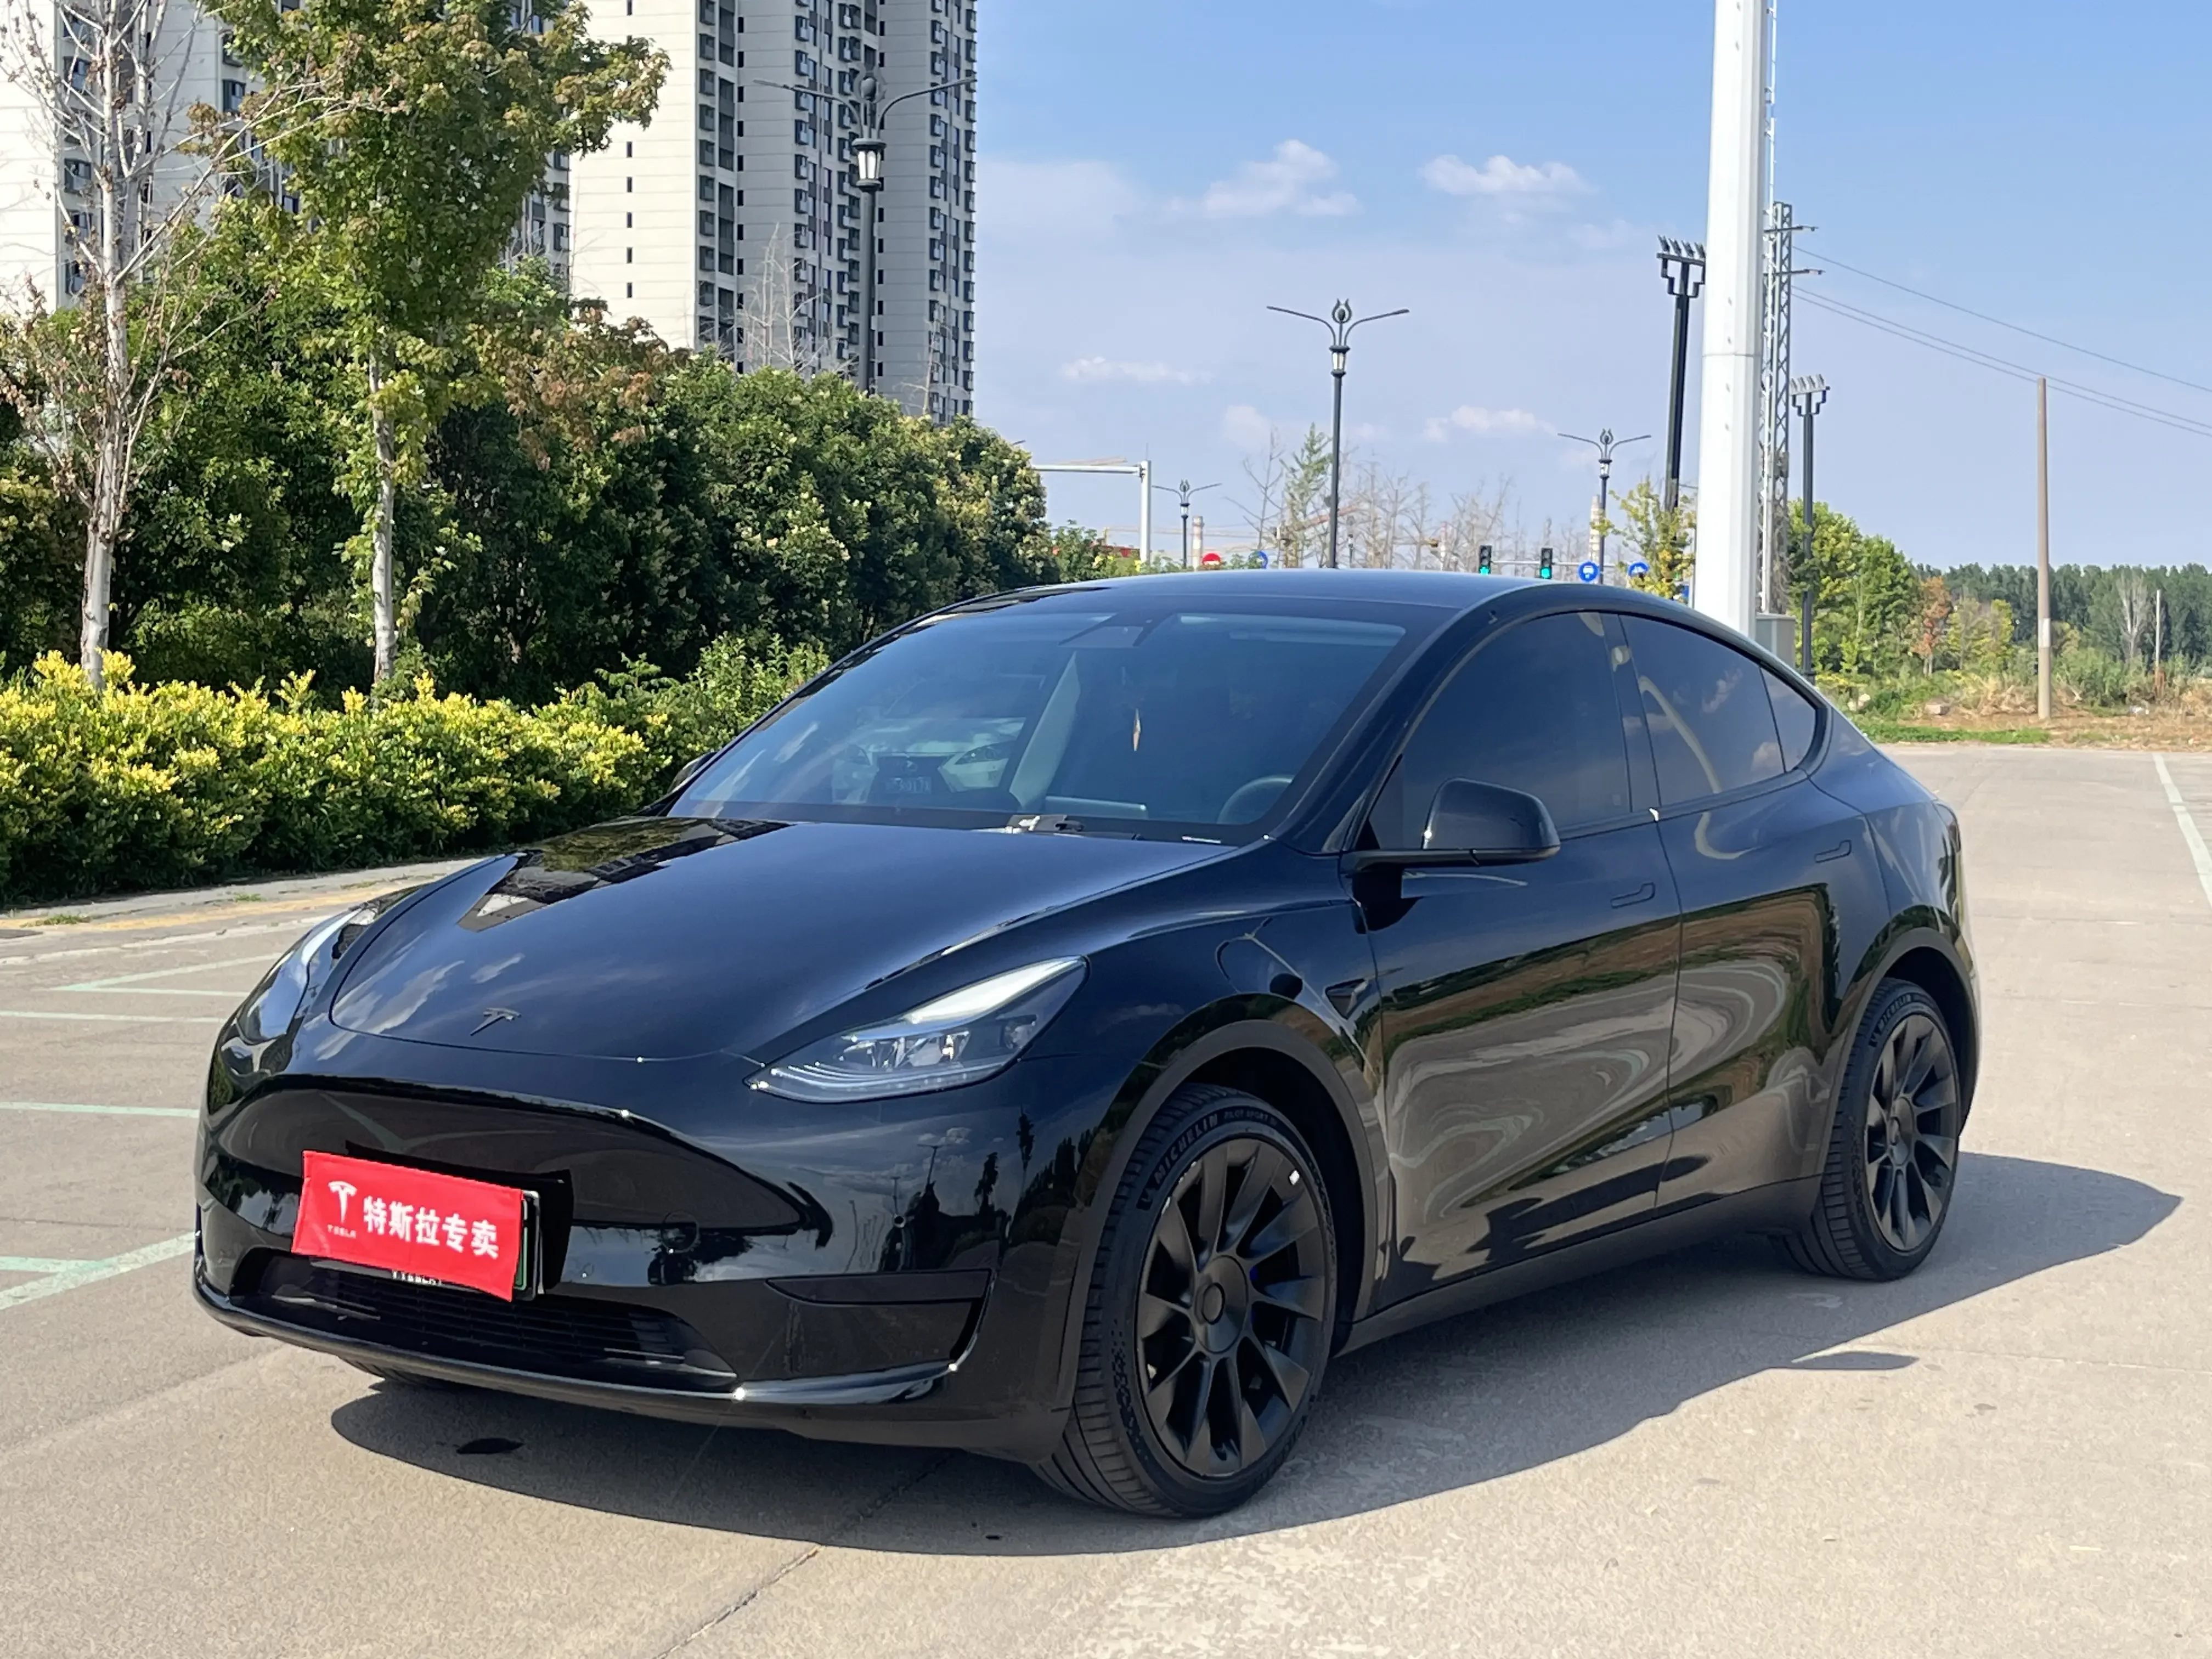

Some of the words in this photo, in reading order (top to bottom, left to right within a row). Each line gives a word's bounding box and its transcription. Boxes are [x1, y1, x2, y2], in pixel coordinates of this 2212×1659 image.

[1154, 1113, 1218, 1185] MICHELIN
[363, 1195, 499, 1260] 特斯拉专卖
